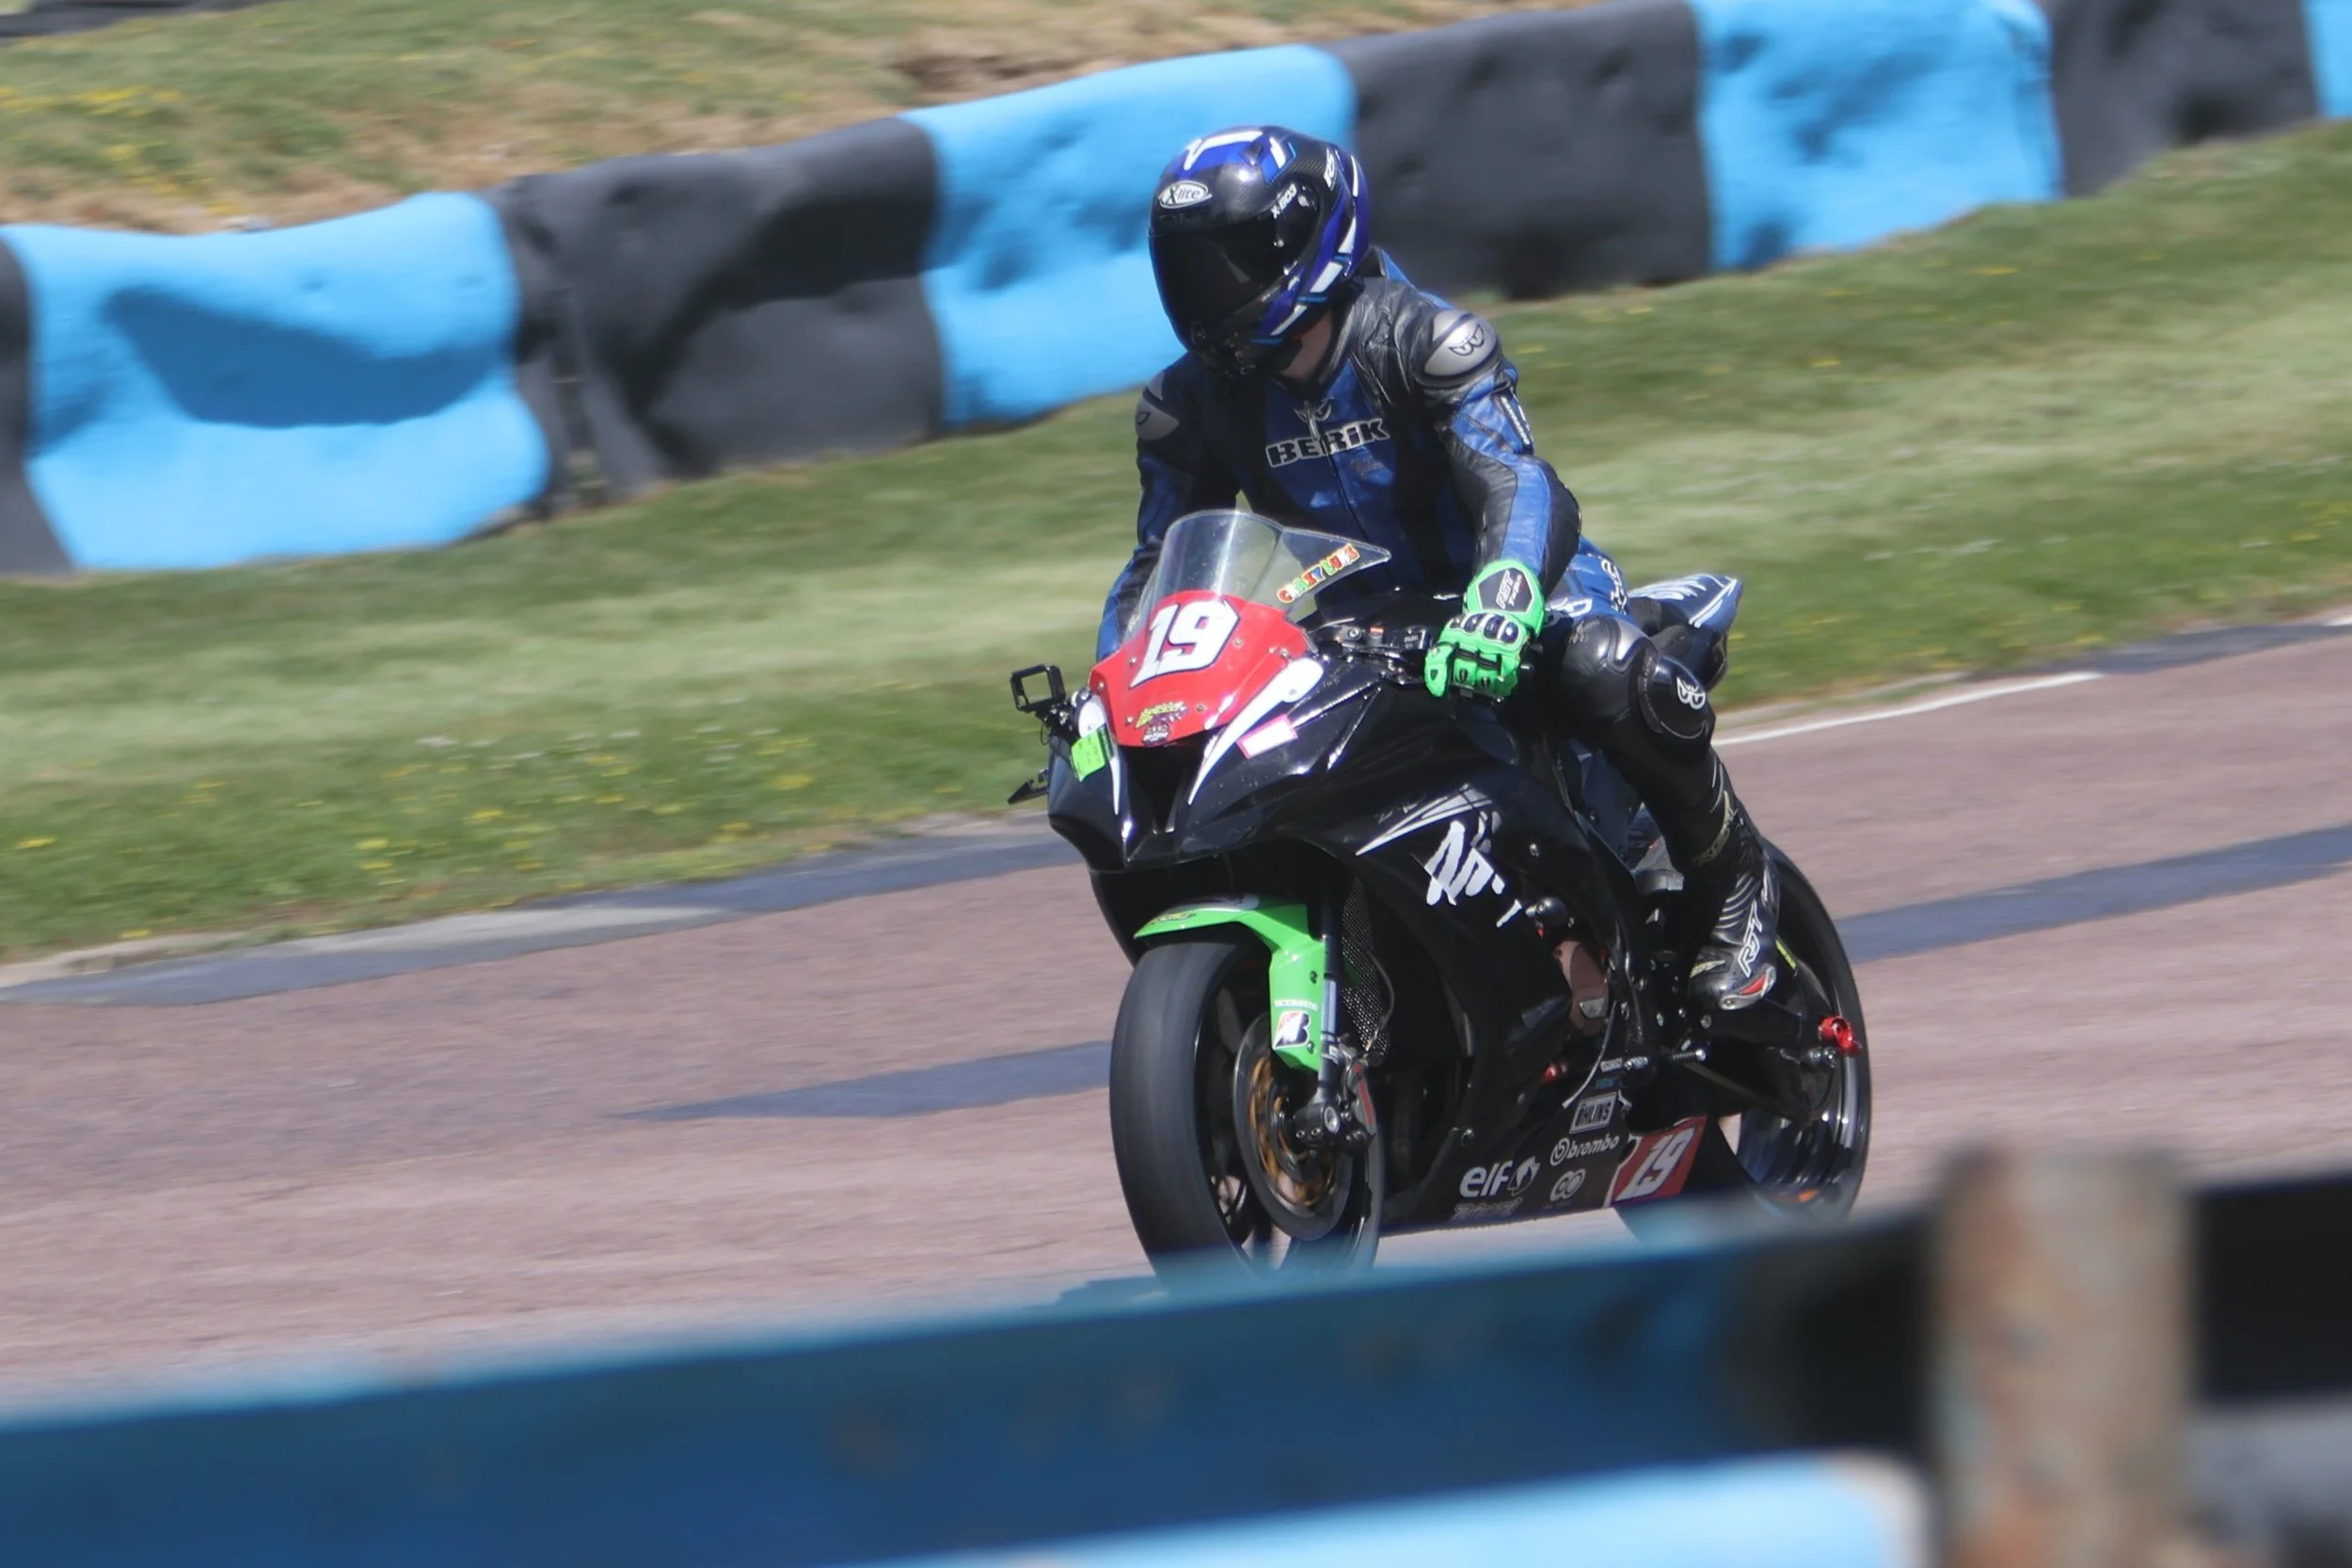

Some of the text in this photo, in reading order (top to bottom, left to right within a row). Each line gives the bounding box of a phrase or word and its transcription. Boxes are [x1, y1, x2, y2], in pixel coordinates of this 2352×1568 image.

[1130, 599, 1240, 689] 19
[1566, 1133, 1620, 1159] brembo
[1615, 1127, 1695, 1201] 19
[1459, 1161, 1514, 1197] elf
